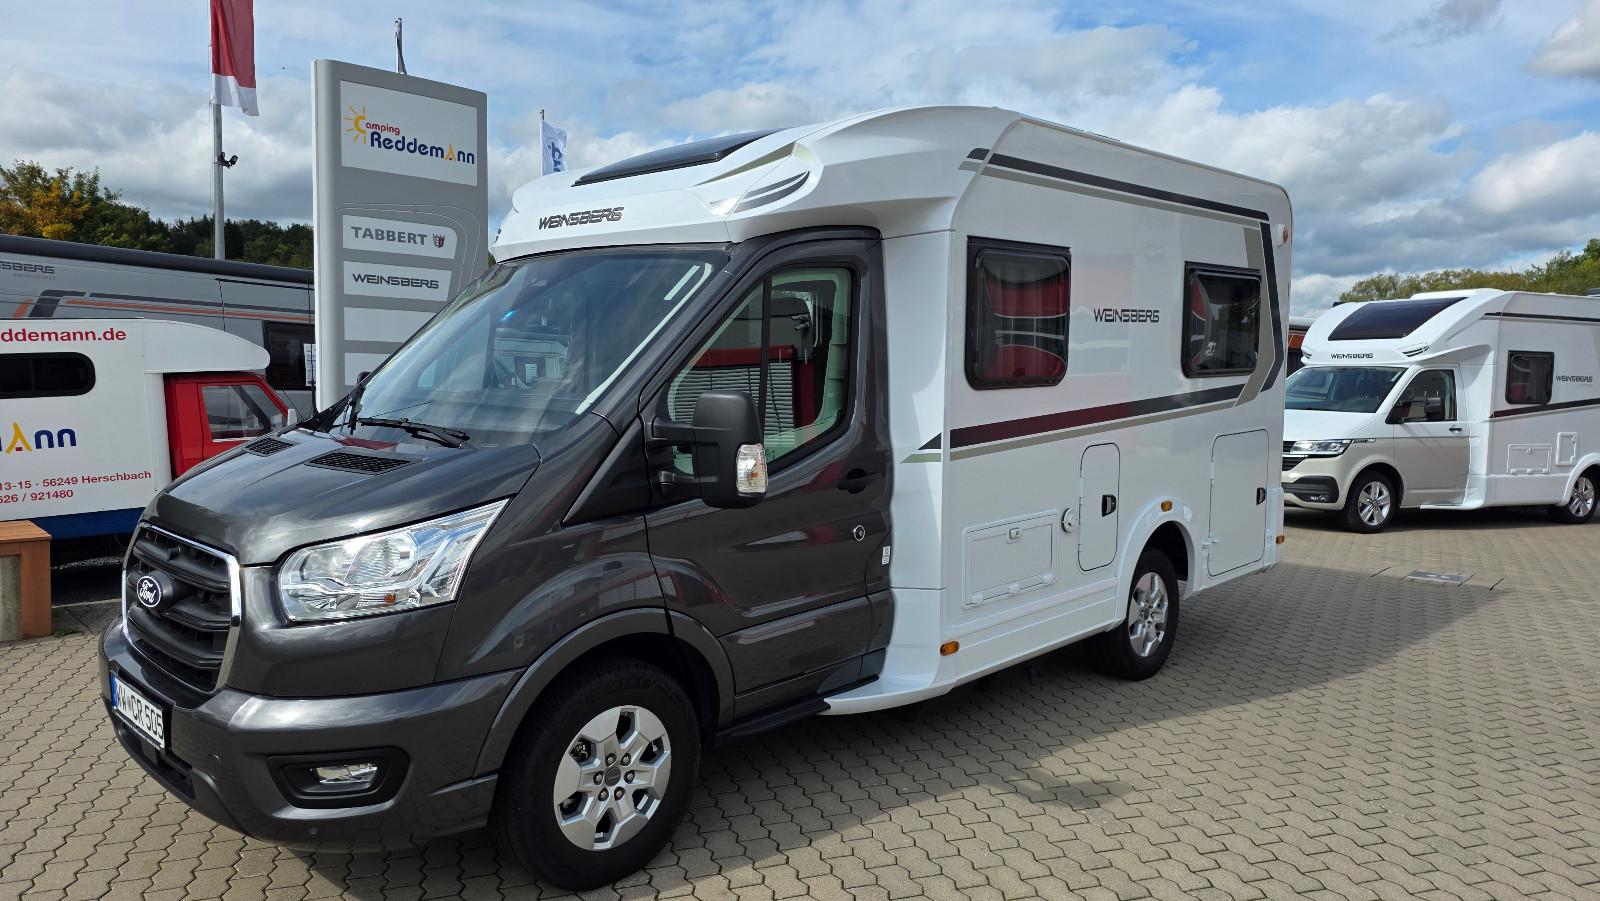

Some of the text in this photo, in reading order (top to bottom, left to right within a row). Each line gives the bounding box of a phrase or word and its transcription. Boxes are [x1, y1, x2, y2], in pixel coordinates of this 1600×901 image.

[354, 115, 400, 136] Camping
[539, 206, 624, 230] WEINSBERG
[351, 226, 427, 245] TABBERT
[352, 273, 439, 289] WEINSBERG
[1093, 307, 1160, 323] WEINSBERG
[0, 328, 127, 342] ddemann.de
[42, 476, 79, 488] 56249
[81, 470, 152, 484] Herschbach
[30, 489, 74, 501] 921480
[139, 579, 157, 604] Ford
[144, 704, 164, 740] 505
